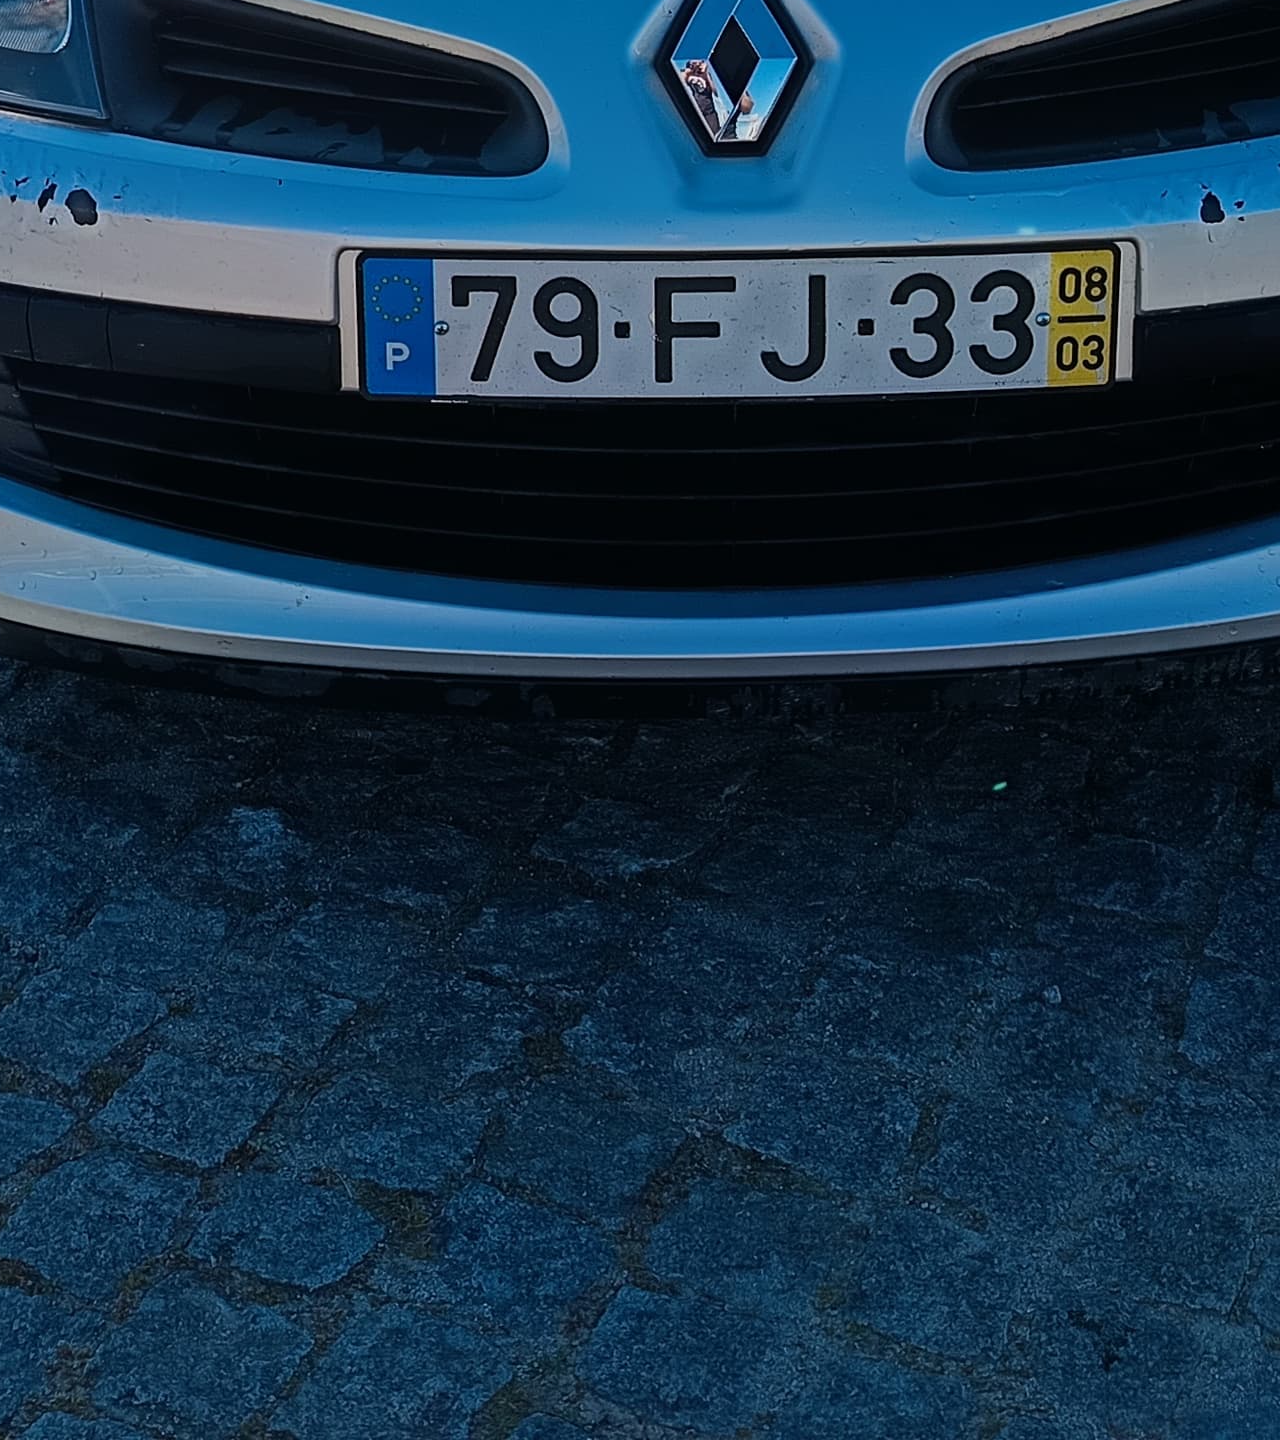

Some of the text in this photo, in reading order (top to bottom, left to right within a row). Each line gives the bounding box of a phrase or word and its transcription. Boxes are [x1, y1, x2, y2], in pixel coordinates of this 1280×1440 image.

[1058, 266, 1108, 304] 08
[386, 342, 410, 371] P
[1056, 334, 1105, 372] 03
